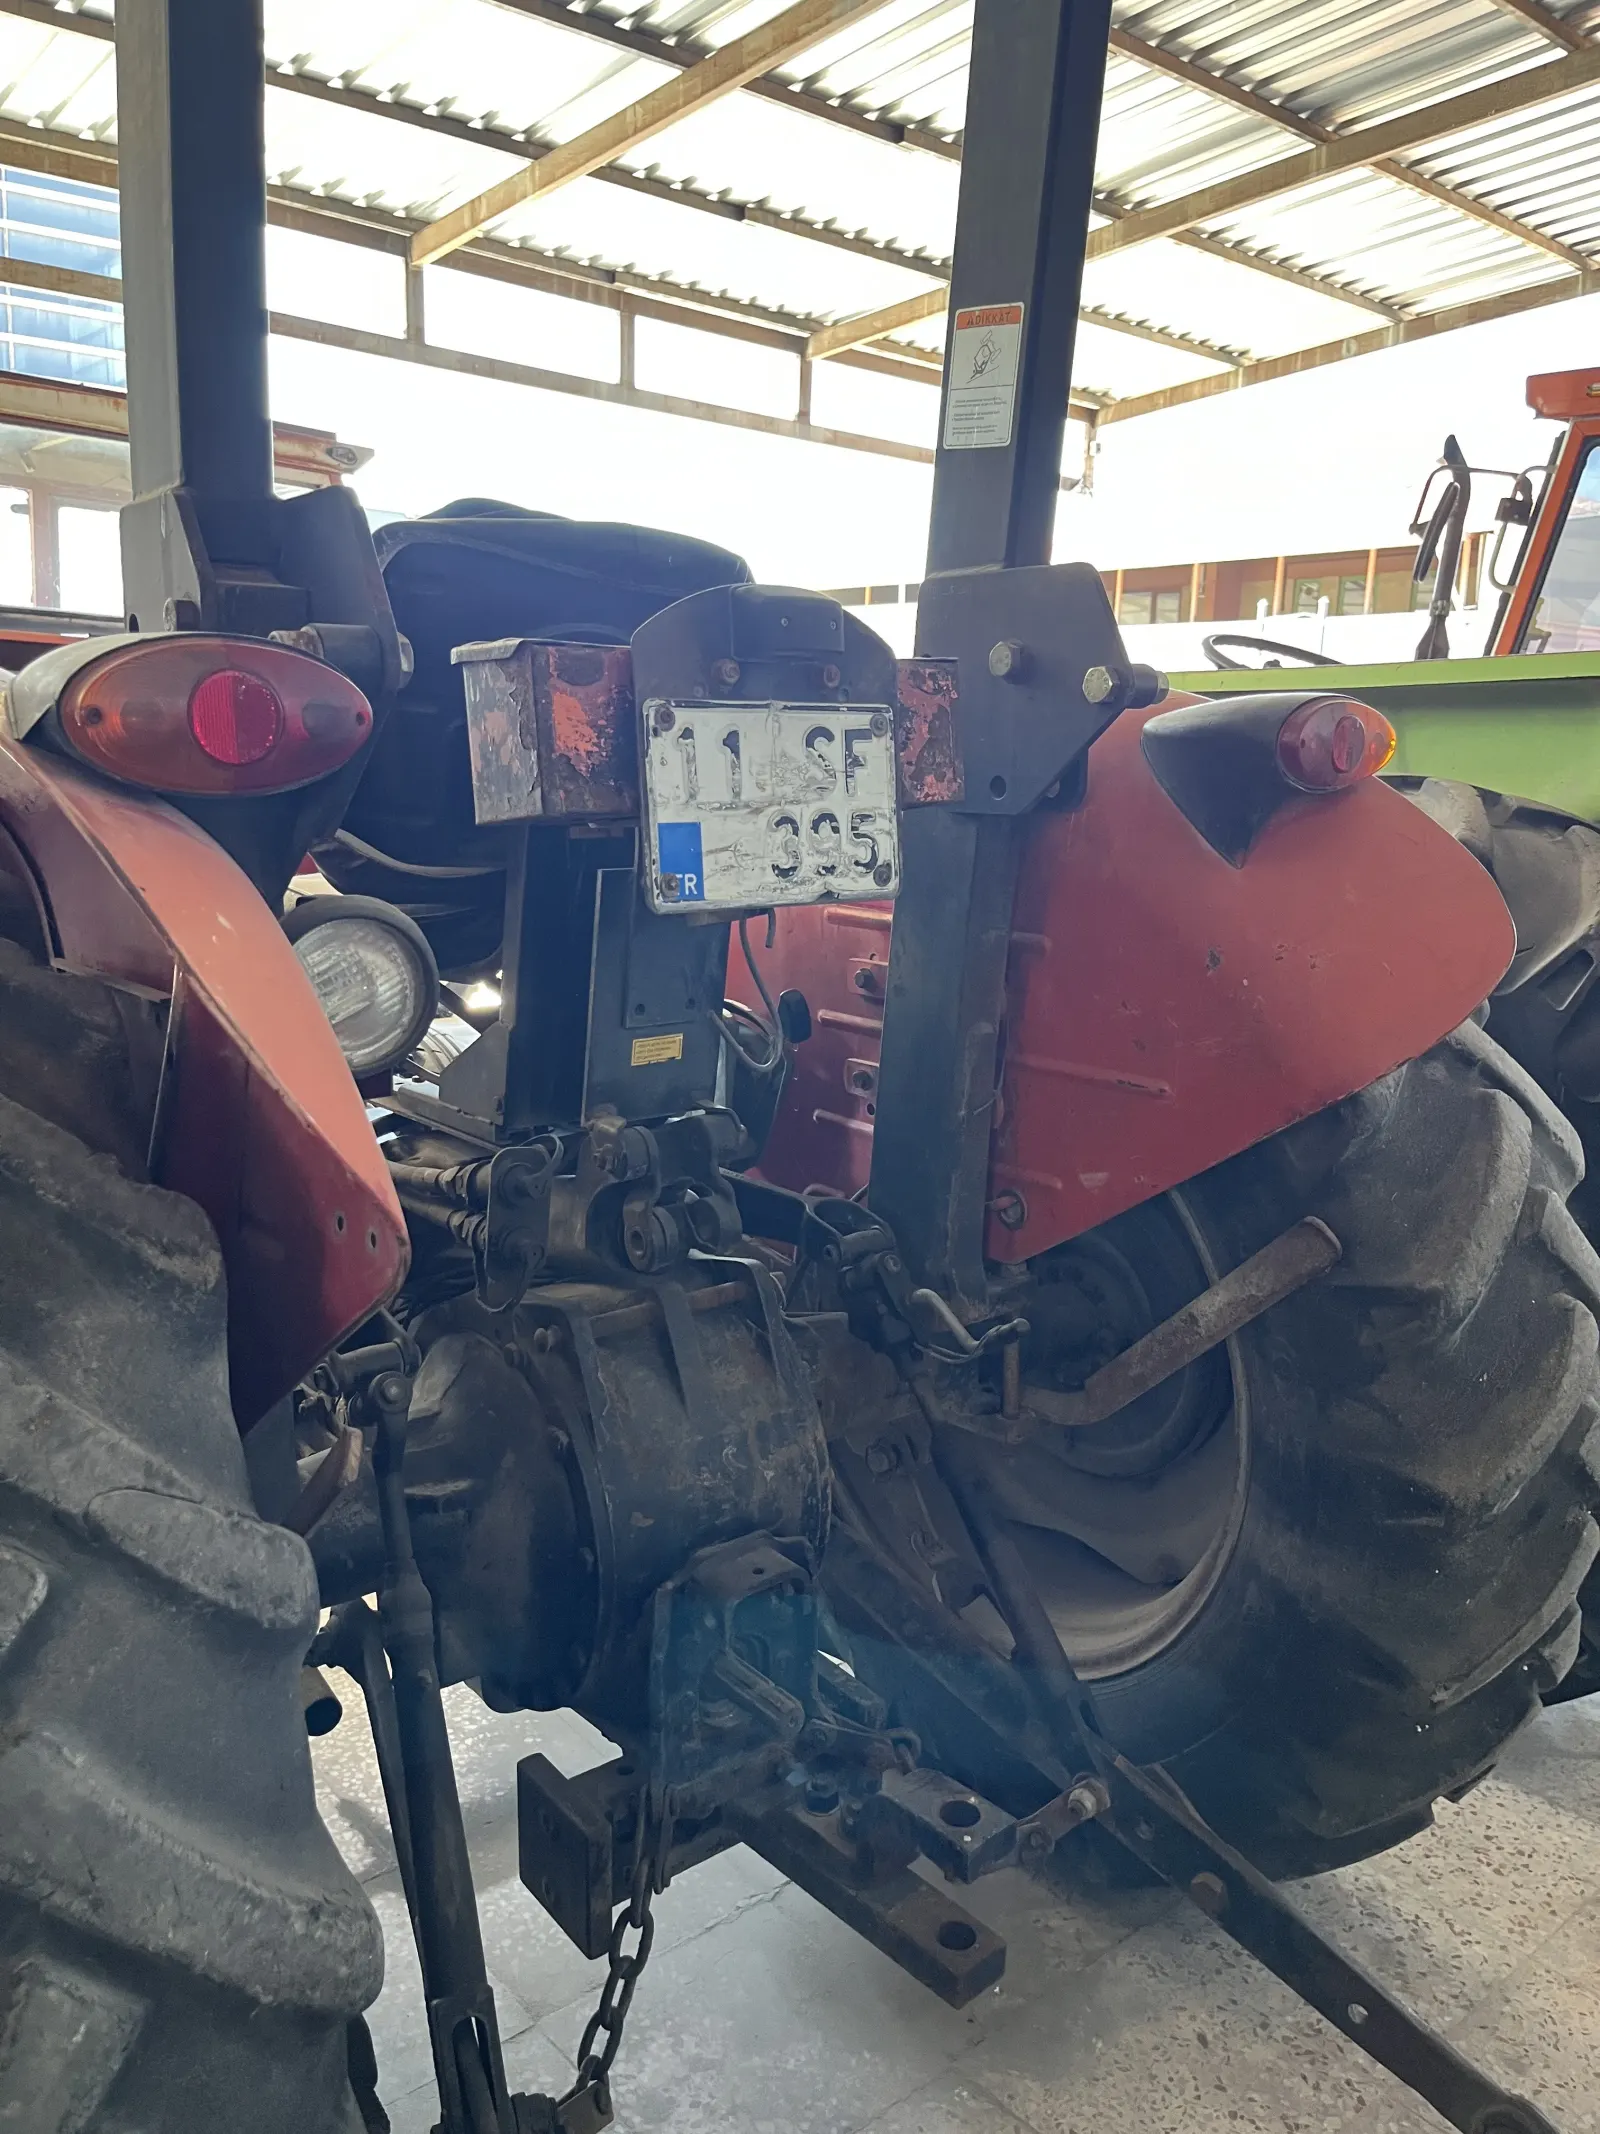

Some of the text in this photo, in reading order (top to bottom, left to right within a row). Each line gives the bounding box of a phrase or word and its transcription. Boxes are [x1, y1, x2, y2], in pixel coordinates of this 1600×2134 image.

[676, 725, 873, 800] 11 SF
[769, 811, 879, 880] 395
